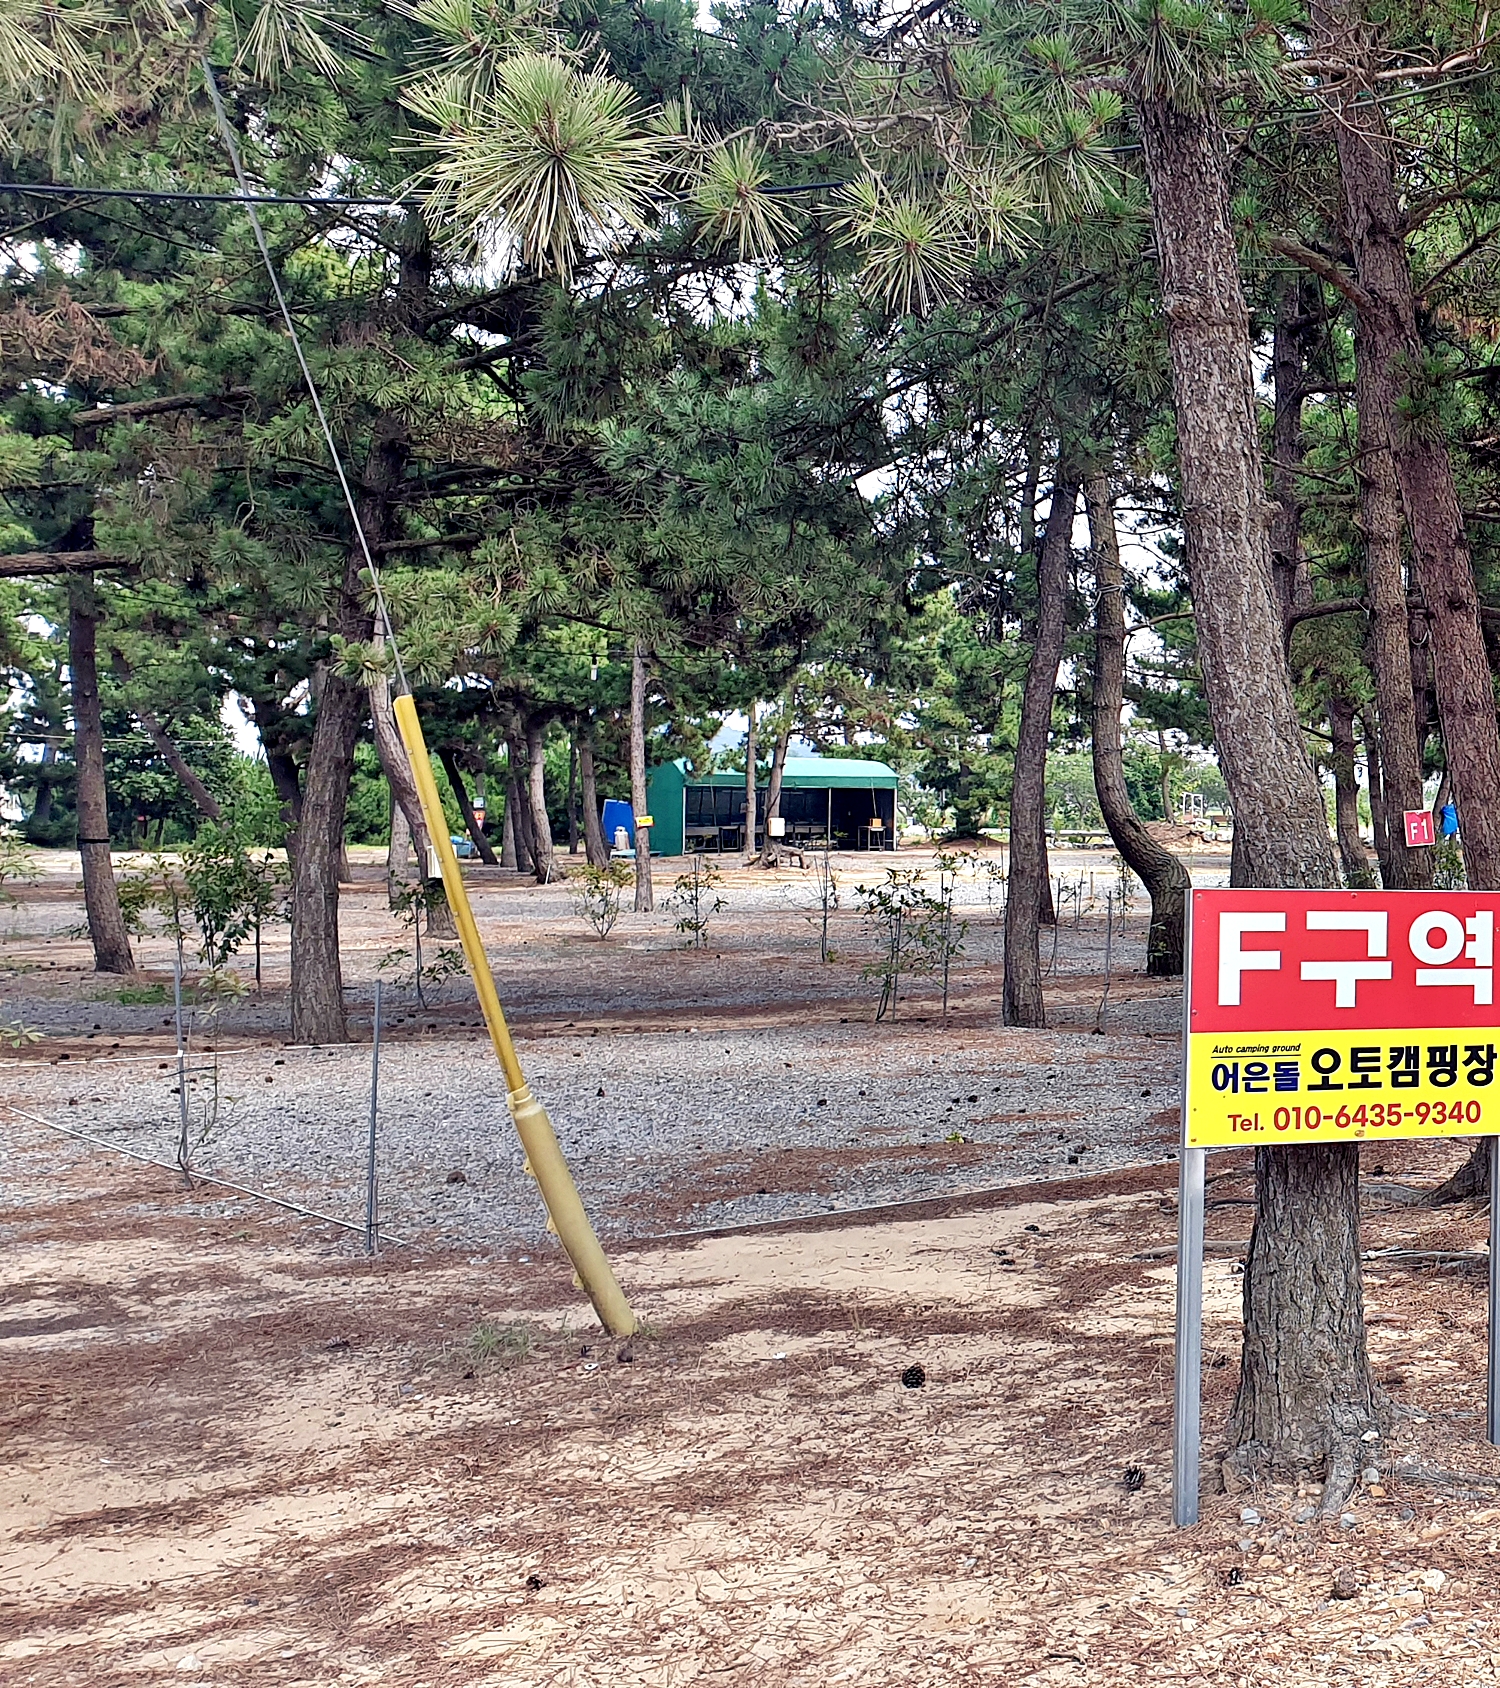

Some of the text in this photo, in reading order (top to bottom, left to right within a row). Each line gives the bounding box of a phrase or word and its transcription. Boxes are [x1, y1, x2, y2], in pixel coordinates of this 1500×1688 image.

[1410, 818, 1429, 841] F1
[1217, 910, 1494, 1008] F구역
[1212, 1043, 1301, 1054] Auto camping ground
[1211, 1043, 1498, 1094] 어은돌 오토캠핑장
[1227, 1100, 1482, 1132] Tel. 010-6435-9340
